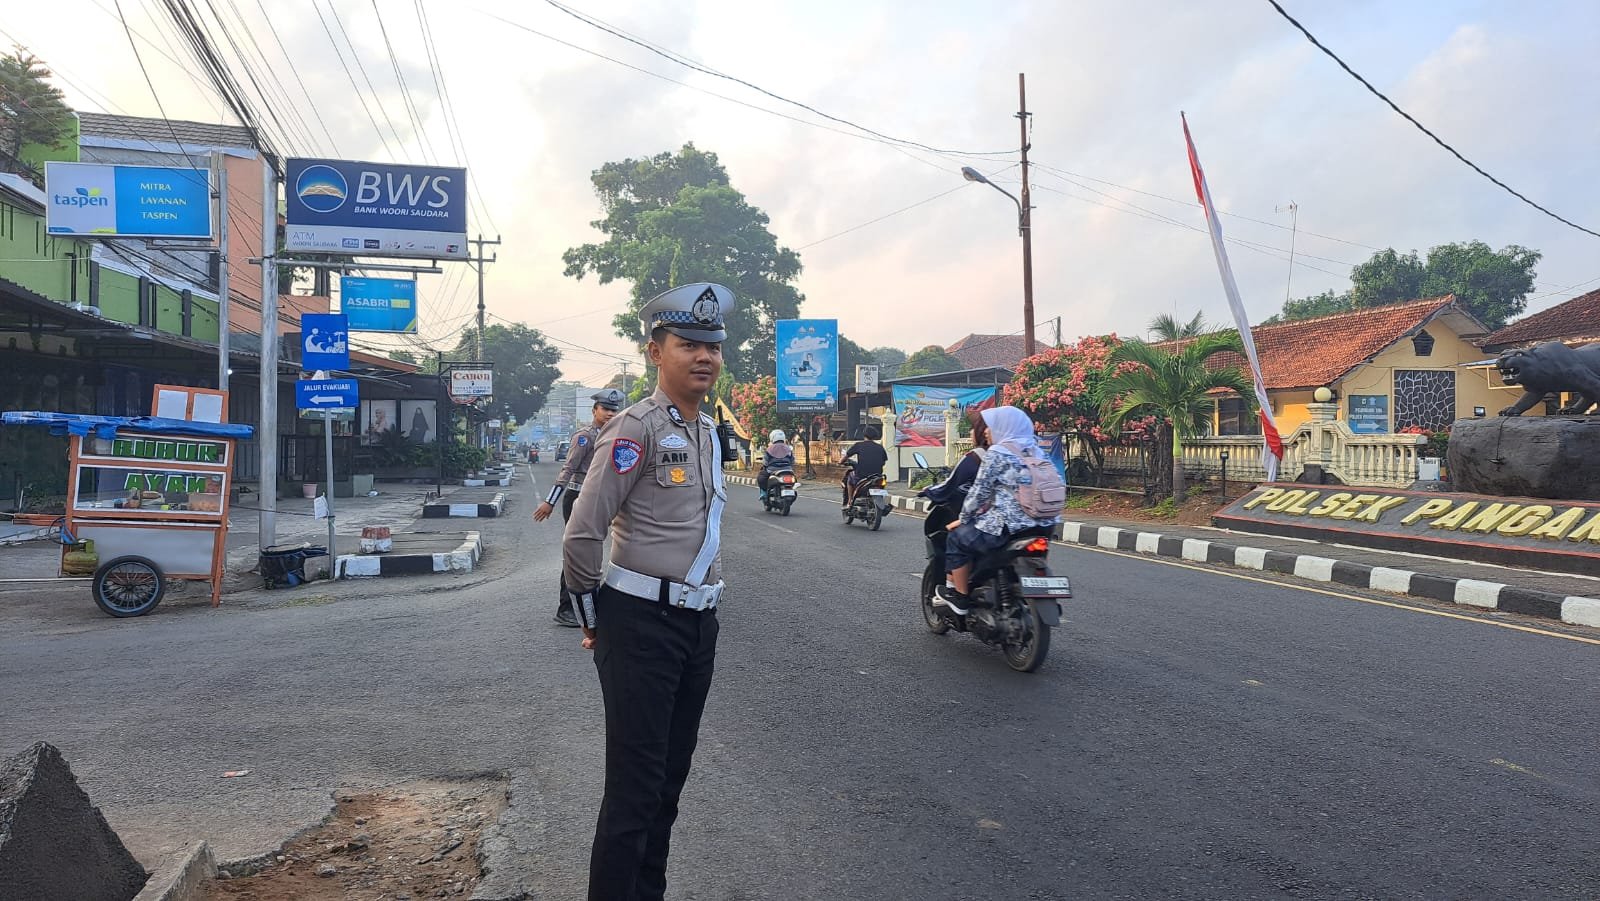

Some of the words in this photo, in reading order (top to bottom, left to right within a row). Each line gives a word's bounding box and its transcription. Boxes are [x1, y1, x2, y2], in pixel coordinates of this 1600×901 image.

[140, 182, 172, 192] MITRA
[355, 171, 452, 209] BWS
[54, 193, 108, 208] taspen
[140, 196, 187, 206] LAYANAN
[141, 210, 178, 220] TASPEN
[354, 206, 378, 215] BANK
[379, 206, 409, 217] WOORI
[410, 208, 449, 219] SAUDARA
[292, 231, 315, 241] ATM
[347, 297, 389, 307] ASABRI
[453, 372, 490, 381] Canon
[303, 384, 322, 392] JALUR
[322, 383, 351, 391] EVAKUASI
[661, 452, 689, 463] ARIF
[124, 472, 208, 493] AYAM
[1243, 487, 1408, 524] POLSEK
